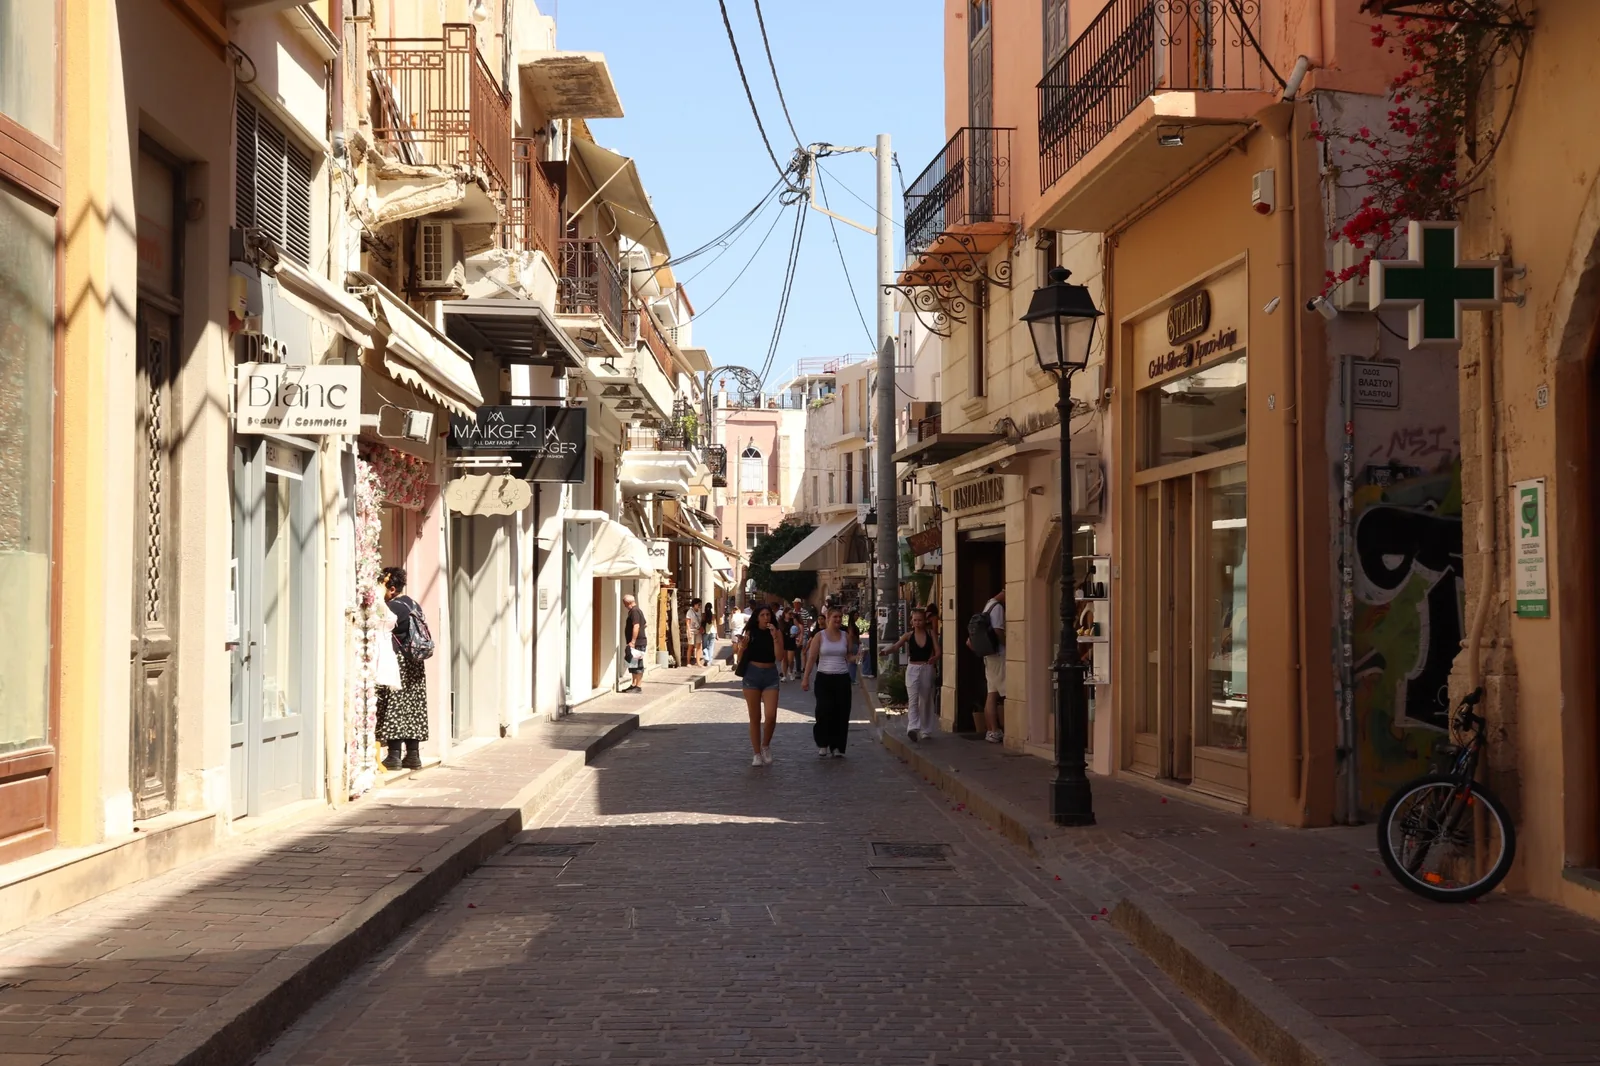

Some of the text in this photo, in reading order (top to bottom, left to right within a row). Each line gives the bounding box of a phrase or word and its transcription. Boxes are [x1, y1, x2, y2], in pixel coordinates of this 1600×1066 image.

[1167, 293, 1203, 342] STELLE
[1362, 368, 1380, 376] ΟΔΟΣ
[1358, 378, 1393, 388] ΒΛΑΣΤΟΥ
[248, 374, 348, 410] Blanc
[1359, 389, 1392, 398] VLASTOU
[1538, 389, 1547, 405] 92
[247, 416, 283, 427] Beauty
[294, 417, 347, 427] Cosmetics
[454, 424, 537, 439] MAIKGER
[539, 442, 577, 454] KGER
